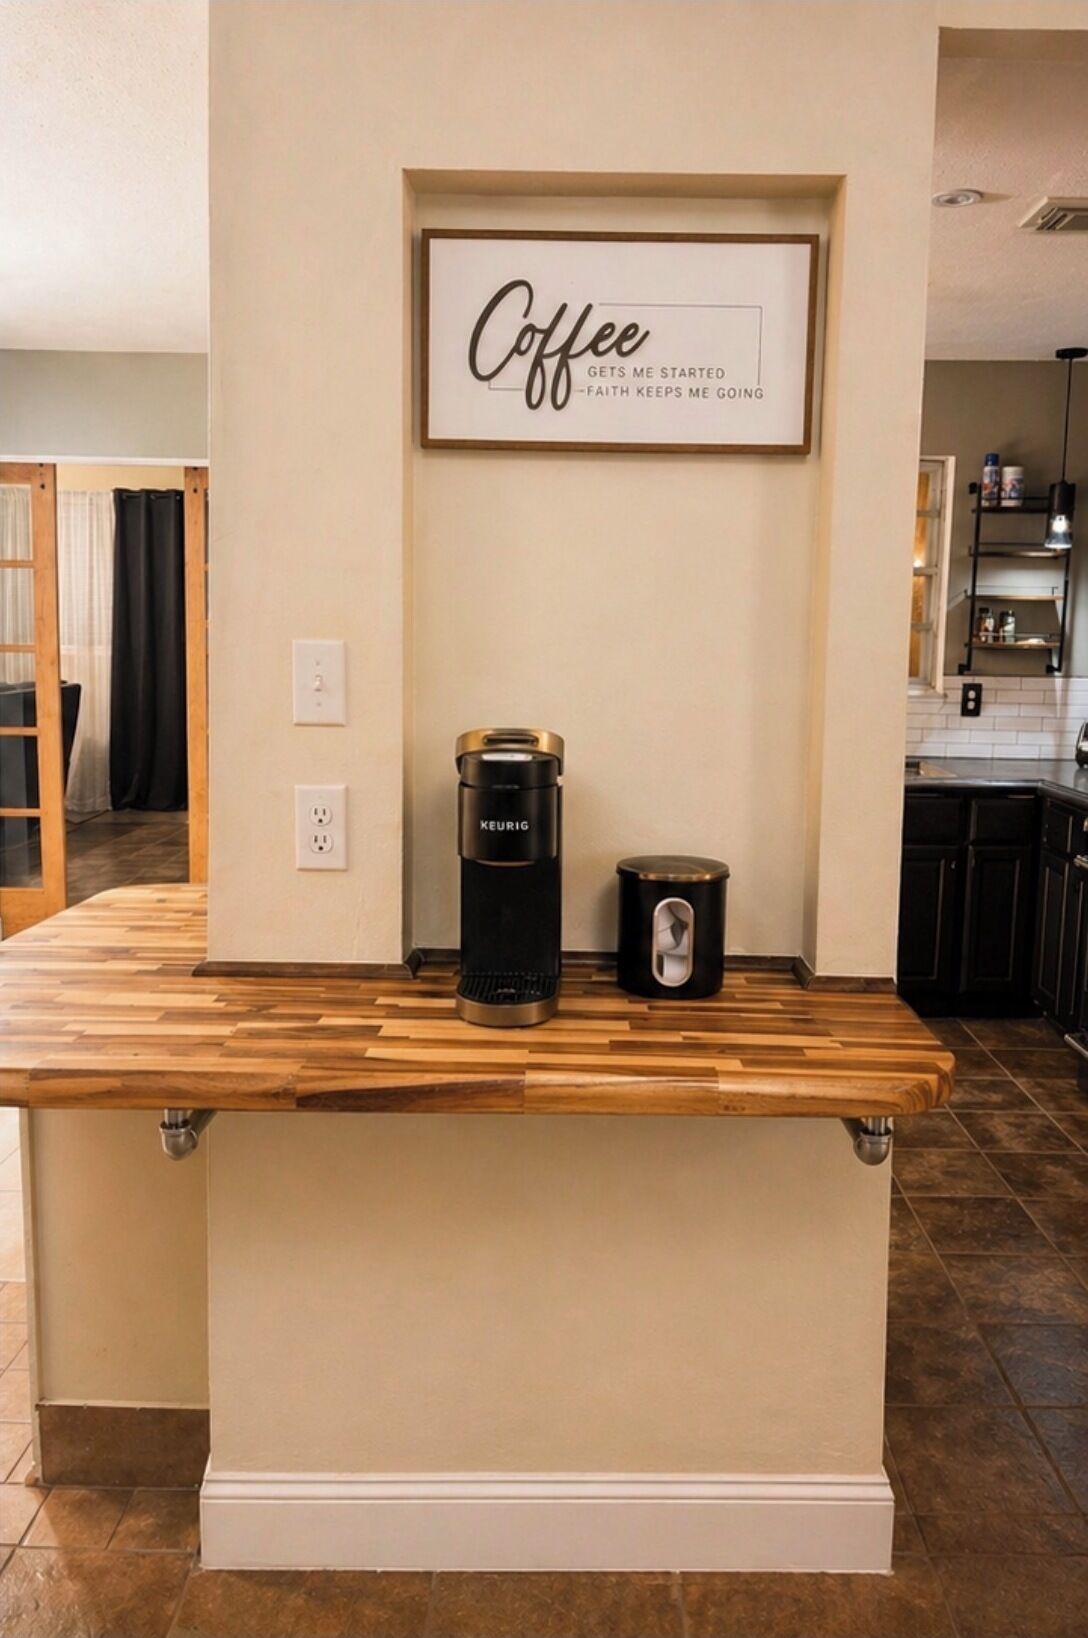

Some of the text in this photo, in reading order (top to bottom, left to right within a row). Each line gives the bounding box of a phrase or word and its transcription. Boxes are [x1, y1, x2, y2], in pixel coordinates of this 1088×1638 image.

[468, 279, 650, 410] Coffee
[587, 366, 725, 380] GETS ME STARTED
[586, 385, 764, 400] FAITH KEEPS ME GOING
[480, 820, 529, 831] KEURIG
